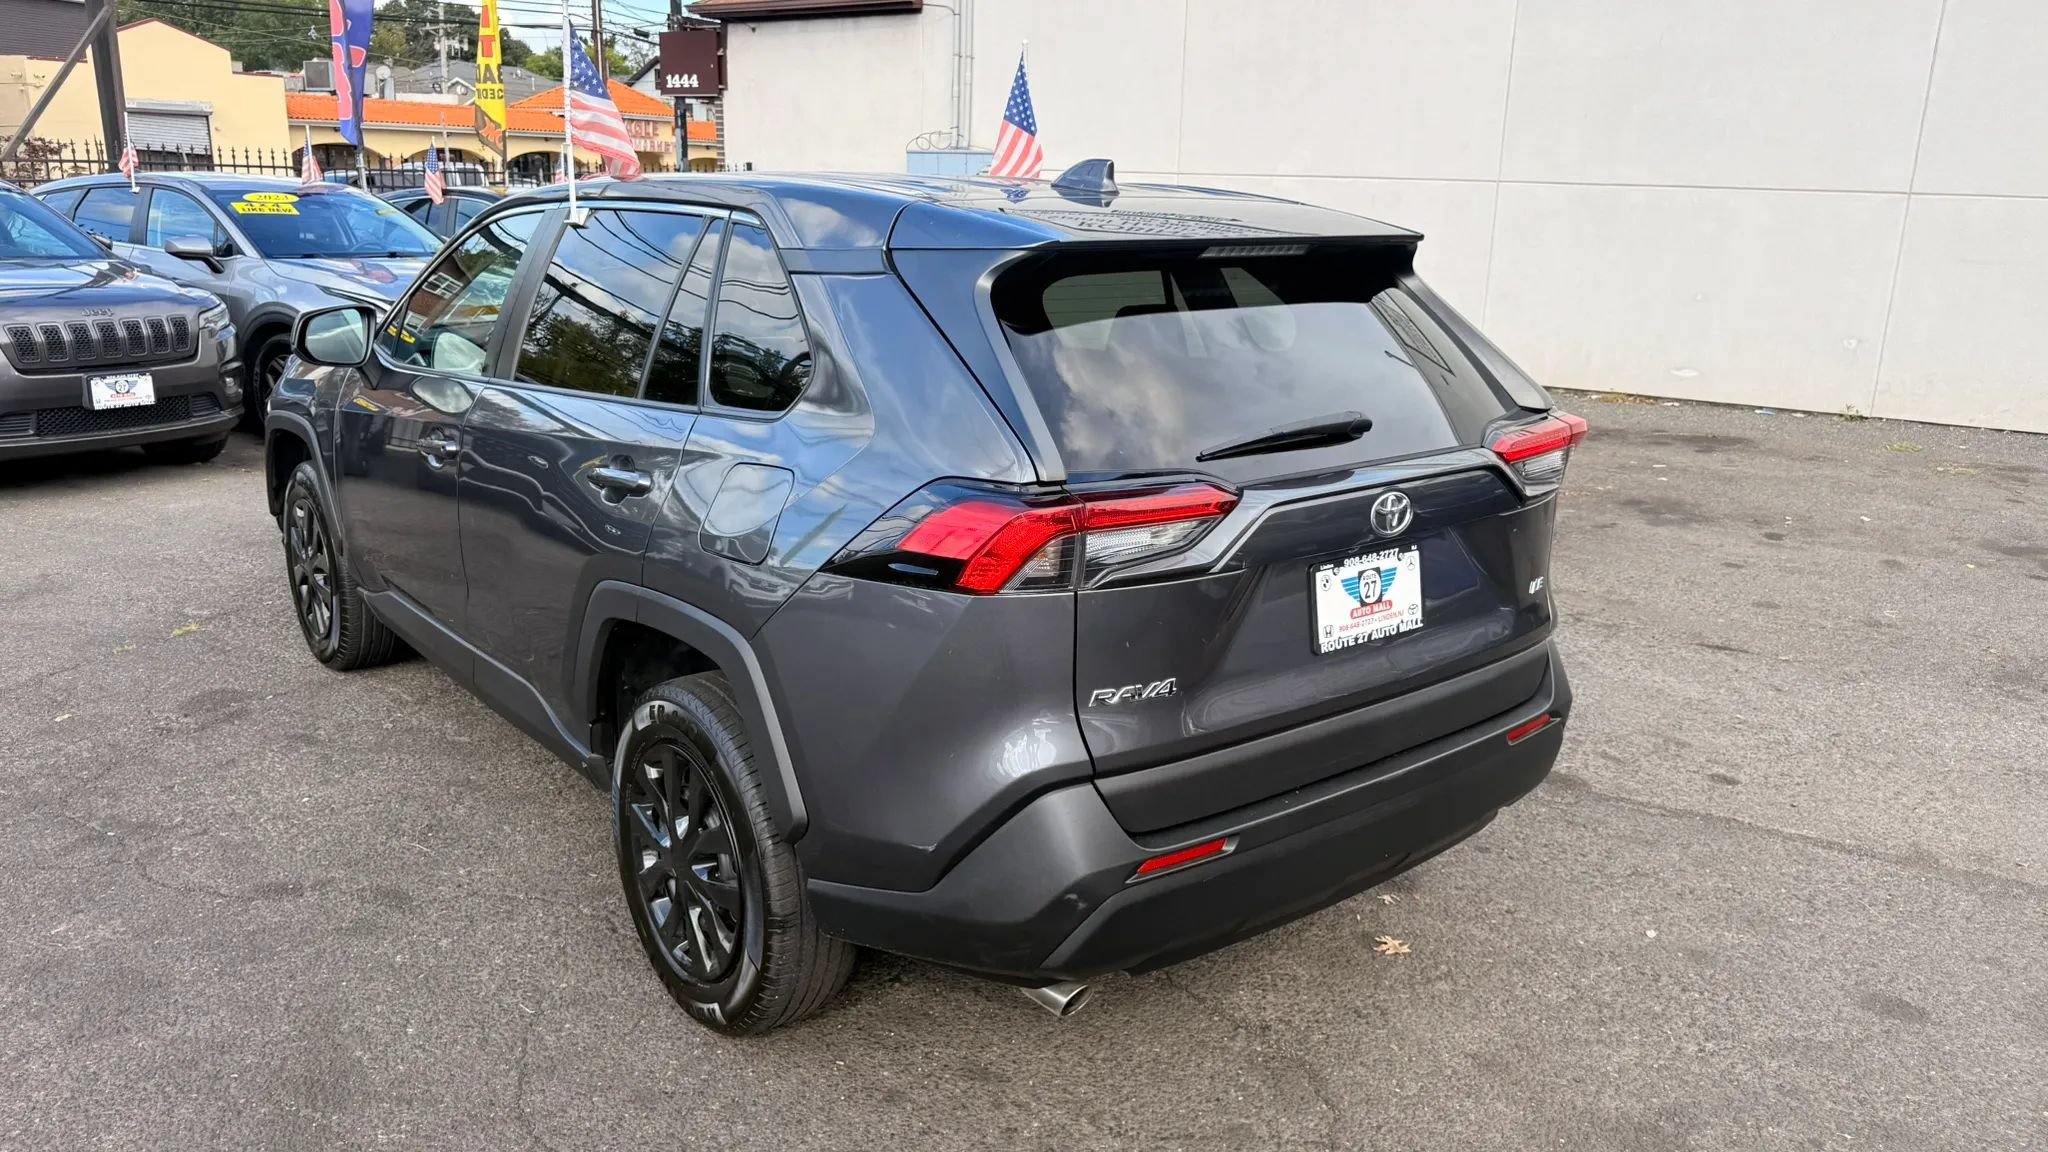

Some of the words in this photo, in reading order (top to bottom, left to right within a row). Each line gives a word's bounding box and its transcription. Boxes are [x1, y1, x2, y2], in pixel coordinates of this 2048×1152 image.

[666, 74, 698, 88] 1444
[1363, 580, 1377, 599] 27
[1352, 606, 1371, 618] AUTO
[1373, 600, 1391, 612] MALL
[1321, 634, 1356, 653] ROUTE
[1357, 631, 1369, 644] 27
[1371, 625, 1397, 640] AUTO
[1399, 618, 1424, 632] MALL
[1088, 678, 1177, 707] RAV4
